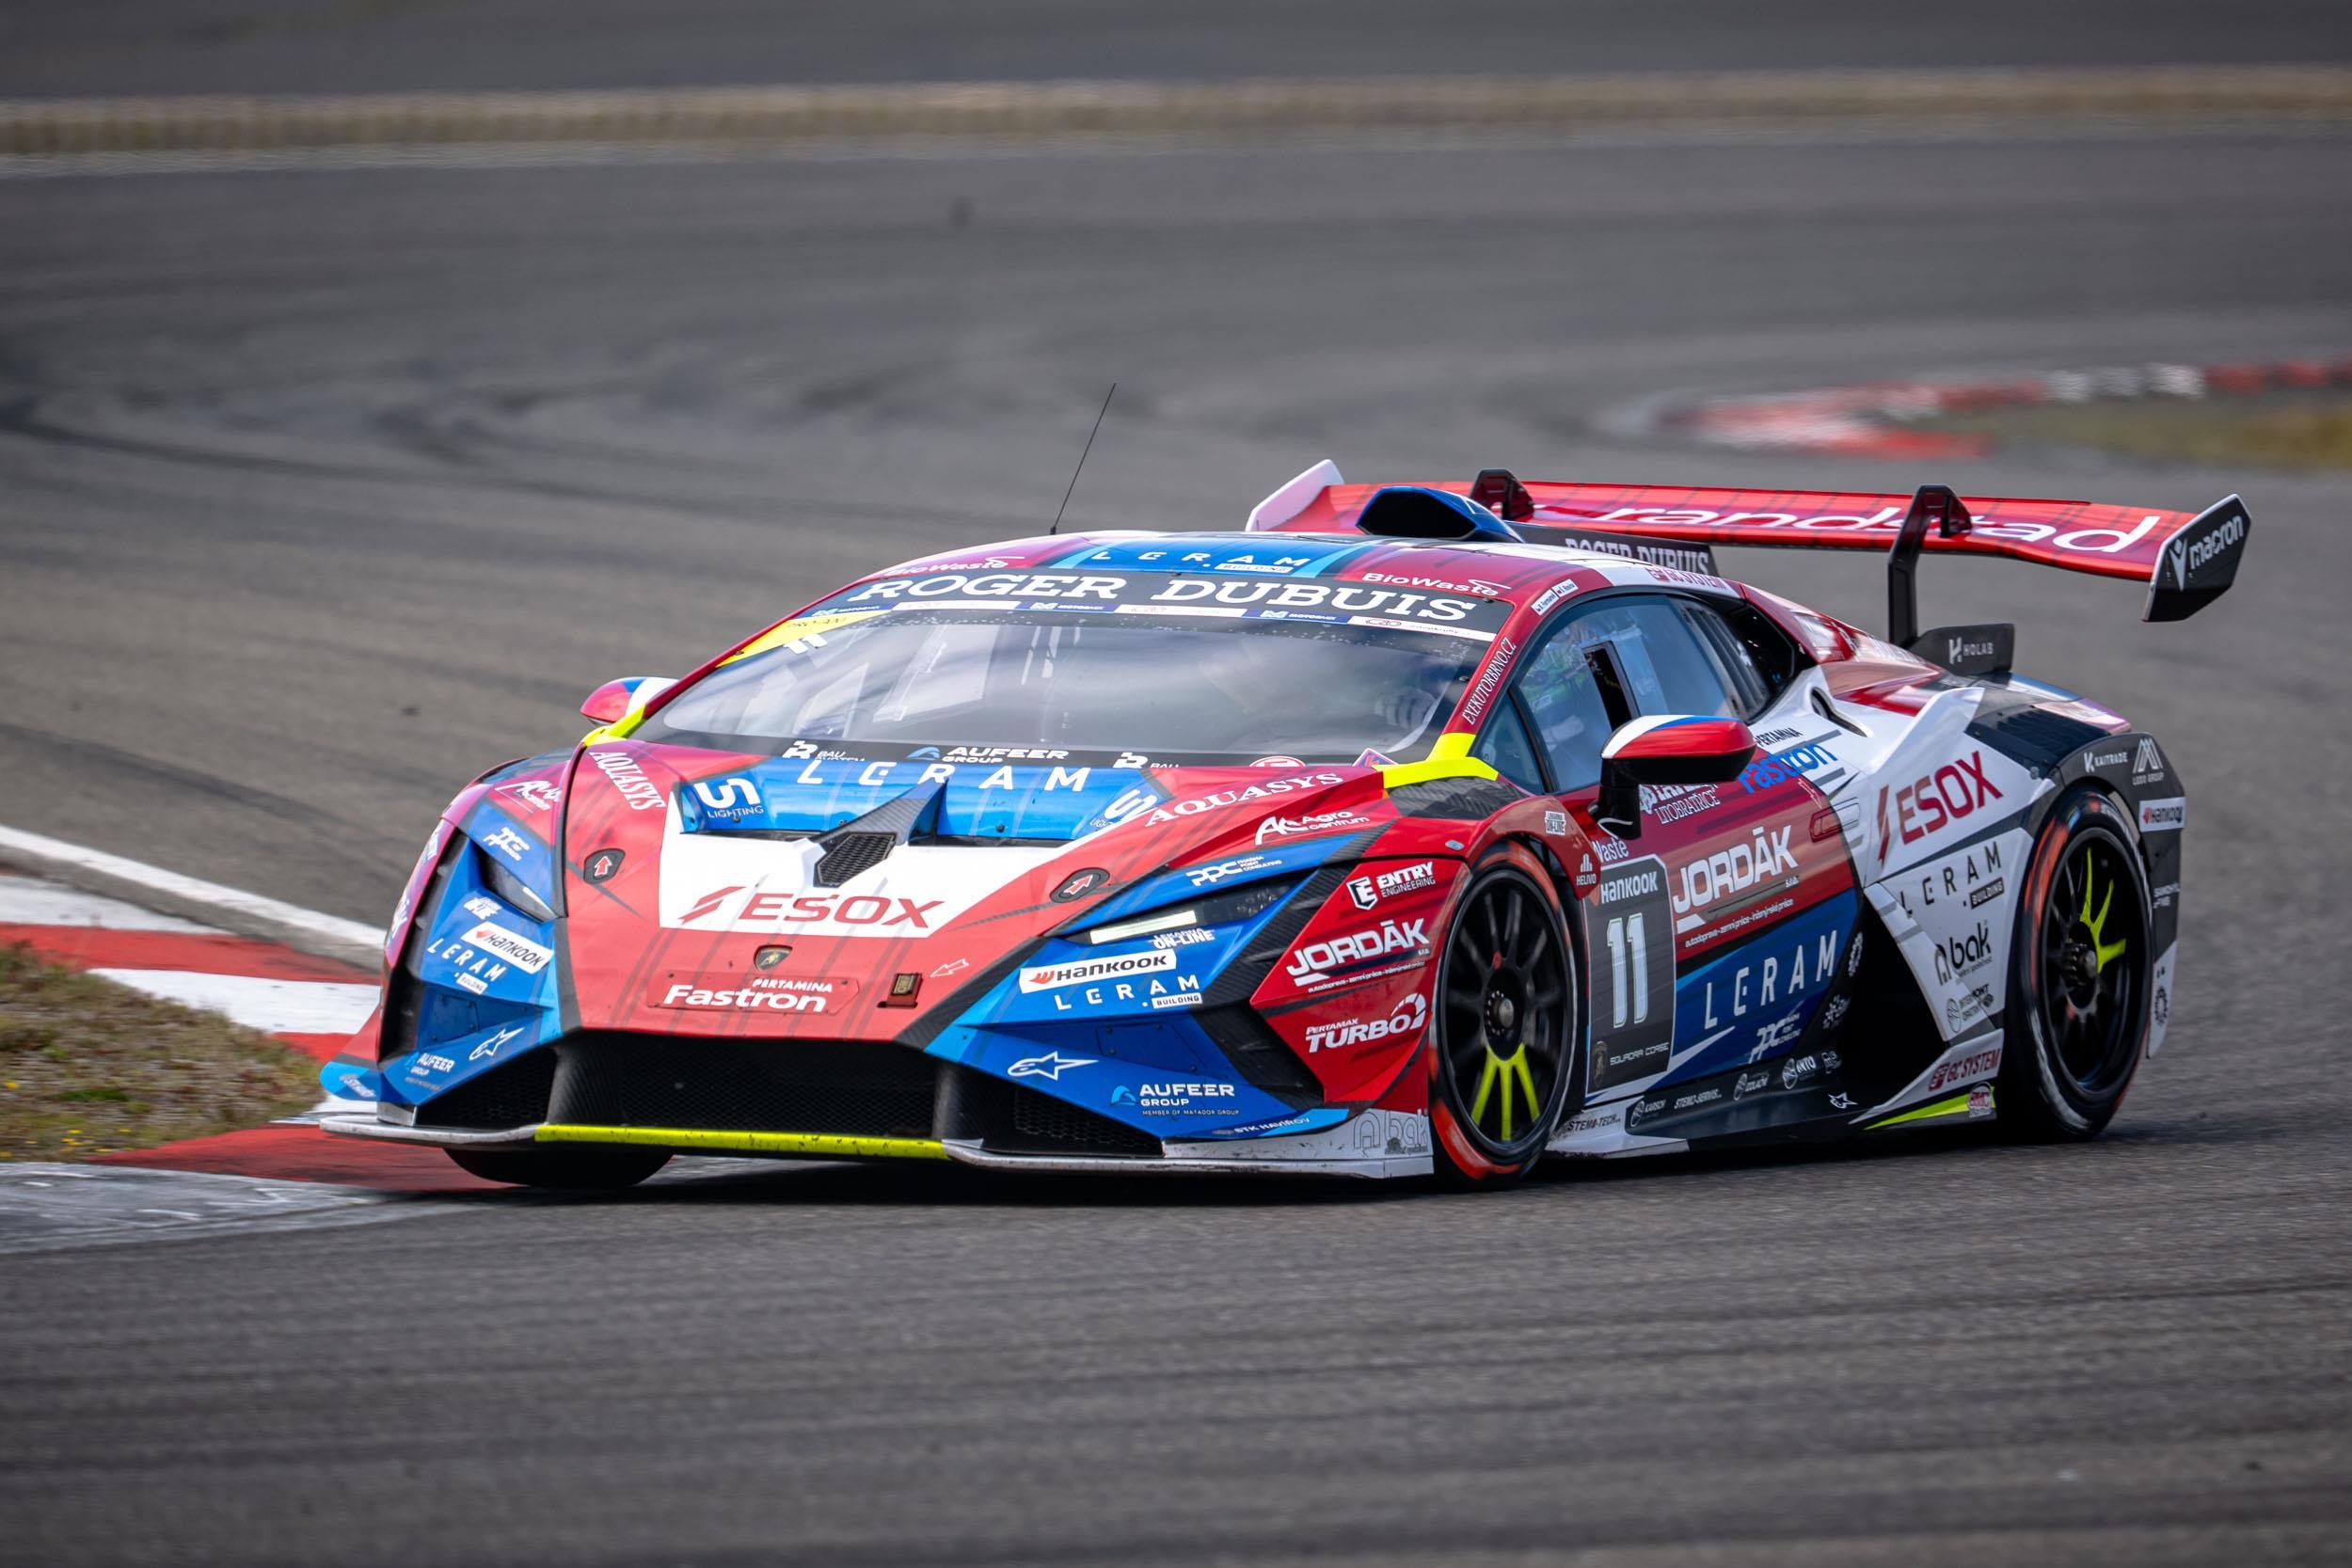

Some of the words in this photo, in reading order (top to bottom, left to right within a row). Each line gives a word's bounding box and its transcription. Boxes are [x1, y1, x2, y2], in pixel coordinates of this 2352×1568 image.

[2190, 515, 2243, 571] macron
[1091, 551, 1311, 566] LERAM
[848, 575, 1127, 602] ROGER
[1150, 579, 1477, 621] DUBUIS
[1362, 573, 1499, 595] BioWaste
[1462, 637, 1518, 725] EXEKUTORBRNO.CZ
[1756, 728, 1804, 748] PERTAMINA
[947, 747, 1070, 759] AUFEER
[589, 752, 666, 810] AQUASYS
[797, 760, 1090, 792] LERAM
[707, 805, 764, 819] LIGHTING
[1144, 773, 1344, 827] AQUASYS
[1896, 751, 2004, 845] ESOX
[1302, 812, 1354, 824] Agro
[1309, 816, 1370, 830] centrum
[1376, 862, 1433, 888] ENTRY
[1382, 876, 1436, 897] ENGINEERING
[1899, 840, 2002, 918] LERAM
[738, 894, 946, 928] ESOX
[427, 938, 506, 982] LERAM
[1606, 912, 1647, 1029] 11
[753, 979, 833, 993] PERTAMINA
[1055, 974, 1200, 1011] LERAM
[1704, 930, 1837, 1029] LERAM
[664, 985, 826, 1013] Fastron
[1156, 995, 1200, 1006] BUILDING
[1306, 1018, 1359, 1036] PERTAMAX
[1306, 1013, 1415, 1053] TURBO
[417, 1053, 454, 1072] AUFEER
[1139, 1084, 1235, 1097] AUFEER
